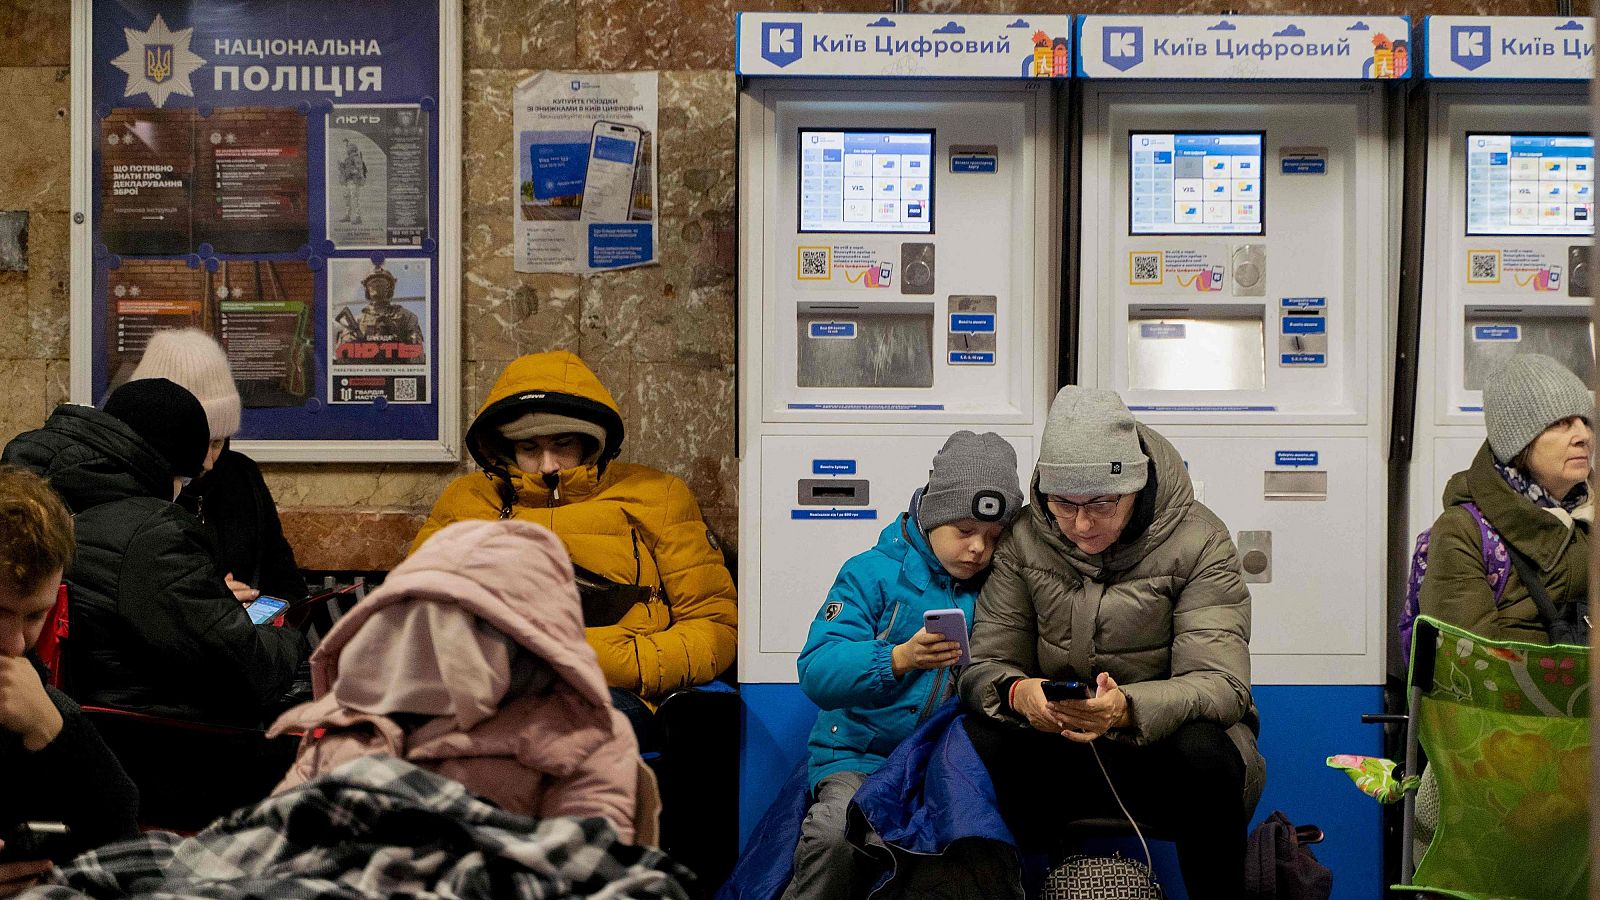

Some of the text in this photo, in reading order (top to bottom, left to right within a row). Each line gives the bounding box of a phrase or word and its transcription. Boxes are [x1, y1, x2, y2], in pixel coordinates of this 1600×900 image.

[214, 39, 382, 58] НАЦІОНАЛЬНА
[813, 34, 1011, 57] Київ Цифровий
[1153, 37, 1351, 60] Київ Цифровий
[1501, 37, 1556, 56] Київ
[213, 65, 382, 97] ПОЛІЦІЯ
[552, 97, 618, 105] КУПУЙТЕ ПОЇЗДКИ
[113, 180, 183, 188] ДЕКЛАРУВАННЯ
